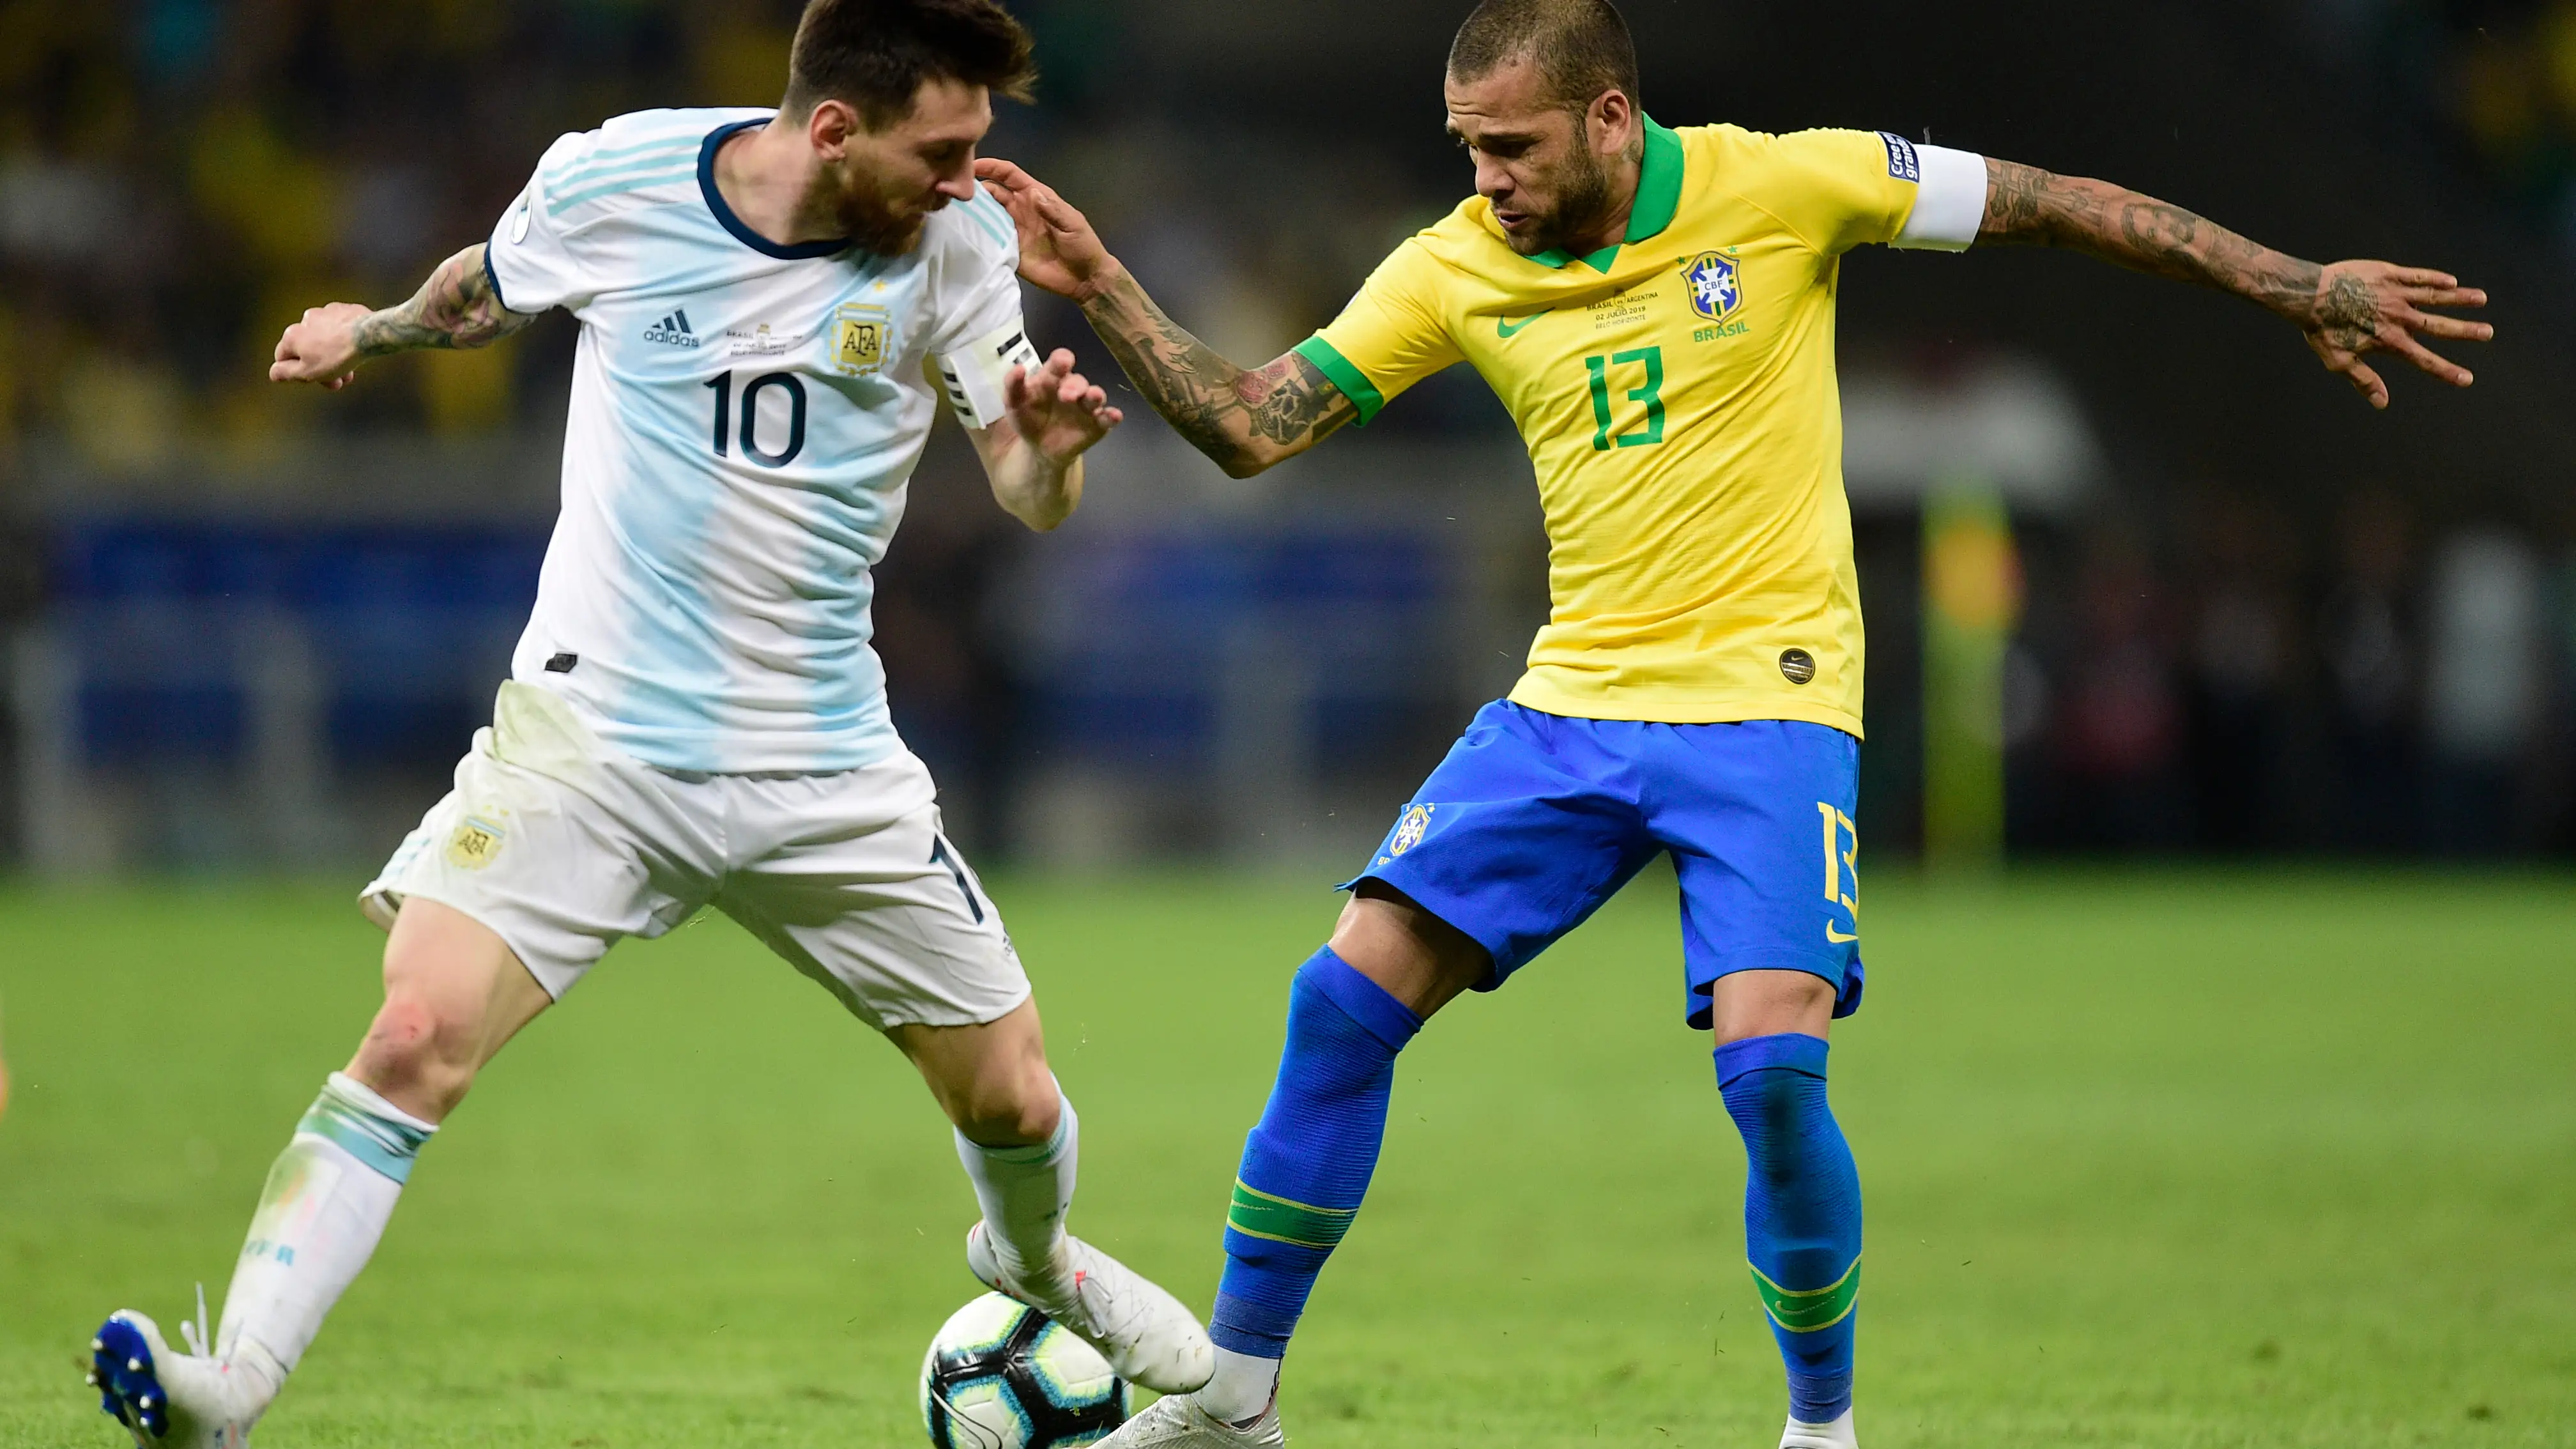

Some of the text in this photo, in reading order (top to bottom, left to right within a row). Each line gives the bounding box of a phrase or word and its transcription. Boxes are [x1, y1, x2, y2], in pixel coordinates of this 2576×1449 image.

[1890, 144, 1904, 175] Cree
[1705, 280, 1723, 291] CBF
[1586, 301, 1613, 311] BRASIL
[1627, 291, 1659, 303] ARGENTINA
[1606, 309, 1628, 319] JULIO
[1629, 305, 1646, 314] 2019
[643, 328, 700, 347] adidas
[844, 323, 877, 356] AFA
[1694, 321, 1750, 342] BRASIL
[1584, 346, 1666, 452] 13
[703, 369, 808, 468] 10
[1817, 801, 1860, 924] 13
